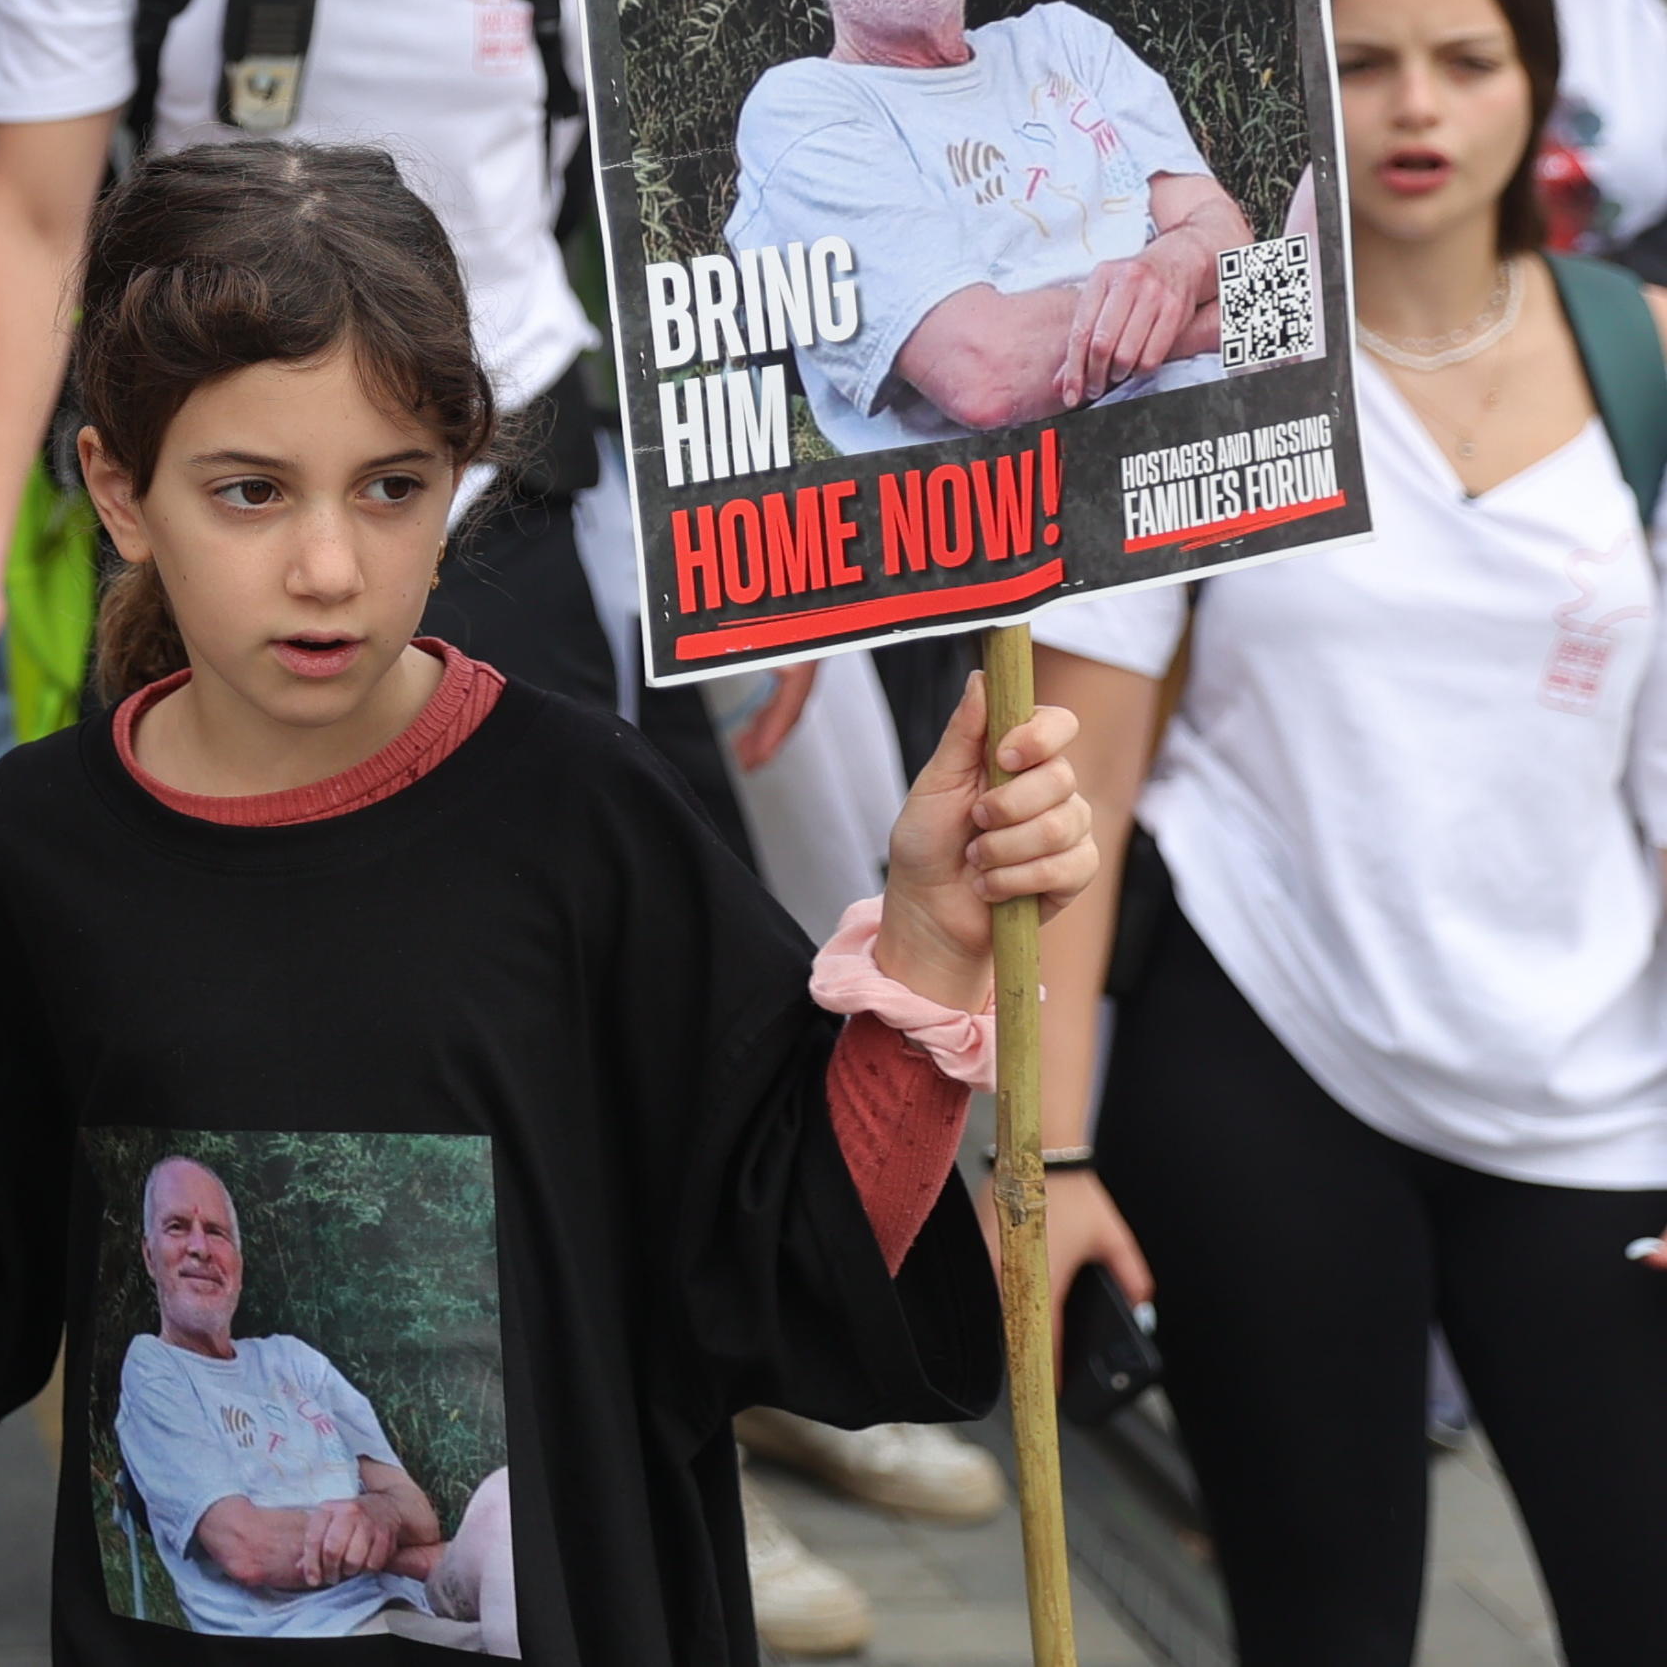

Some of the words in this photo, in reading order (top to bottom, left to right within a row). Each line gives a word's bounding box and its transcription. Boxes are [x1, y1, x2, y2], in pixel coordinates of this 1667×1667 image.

[645, 235, 859, 369] BRING
[658, 364, 791, 487] HIM
[1121, 440, 1215, 490] HOSTAGES
[1217, 432, 1252, 470] AND
[1253, 414, 1332, 462] MISSING
[671, 480, 863, 614] HOME
[878, 428, 1064, 576] NOW!
[1123, 471, 1242, 540] FAMILIES
[1244, 448, 1339, 514] FORUM
